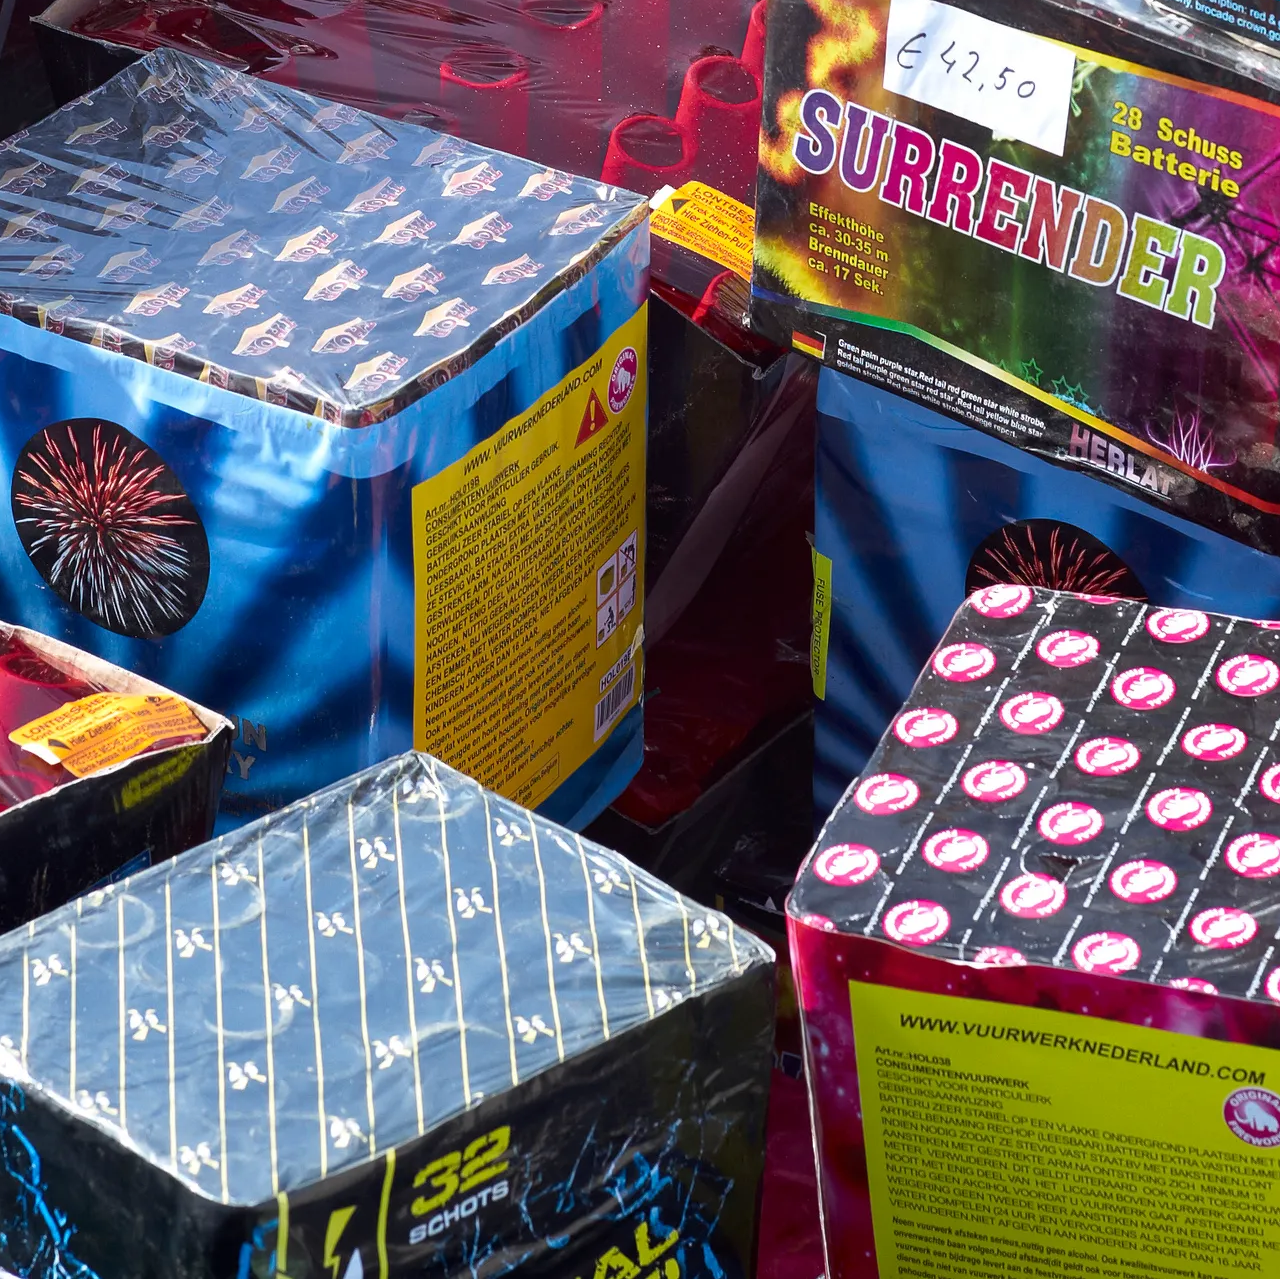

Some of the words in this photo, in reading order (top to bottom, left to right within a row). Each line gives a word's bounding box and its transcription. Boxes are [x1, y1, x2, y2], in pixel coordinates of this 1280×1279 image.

[896, 33, 926, 71] €
[941, 40, 1037, 99] 42,50
[1109, 129, 1242, 200] Batterie
[1111, 100, 1143, 132] 28
[1156, 116, 1245, 171] Schuss
[792, 88, 1227, 330] SURRENDER
[809, 201, 885, 243] Effekthöhe
[808, 222, 830, 239] ca.
[834, 229, 872, 256] 30-35
[876, 247, 890, 263] m
[808, 236, 890, 281] Brenndauer
[807, 257, 830, 276] ca.
[833, 263, 851, 281] 17
[854, 271, 885, 296] Sek.
[463, 451, 492, 477] WWW.
[493, 358, 603, 455] VUURWERKNEDERLAND.COM
[1070, 424, 1176, 498] HERLAT
[425, 460, 520, 533] CONSUMENTENVUURWERK
[426, 499, 507, 560] GEBRUIKSAANWIJZING
[875, 1056, 1030, 1090] CONSUMENTENVUURWERK
[899, 1013, 1266, 1087] WWW.VUURWERKNEDERLAND.COM
[876, 1068, 933, 1090] GESCHIKT
[934, 1077, 970, 1094] VOOR
[970, 1082, 1053, 1106] PARTICULIERK
[877, 1080, 1004, 1110] GEBRUIKSAANWIJZING
[878, 1092, 931, 1113] BATTERIJ
[931, 1100, 964, 1118] ZEER
[964, 1105, 1010, 1125] STABIEL
[1010, 1113, 1028, 1128] OP
[1028, 1117, 1054, 1132] EEN
[1055, 1121, 1100, 1140] VLAKKE
[1101, 1128, 1186, 1154] ONDERGROND
[1187, 1144, 1249, 1167] PLAATSEN
[1249, 1153, 1276, 1169] MET
[410, 1125, 511, 1217] 32
[408, 1180, 509, 1245] SCHOTS
